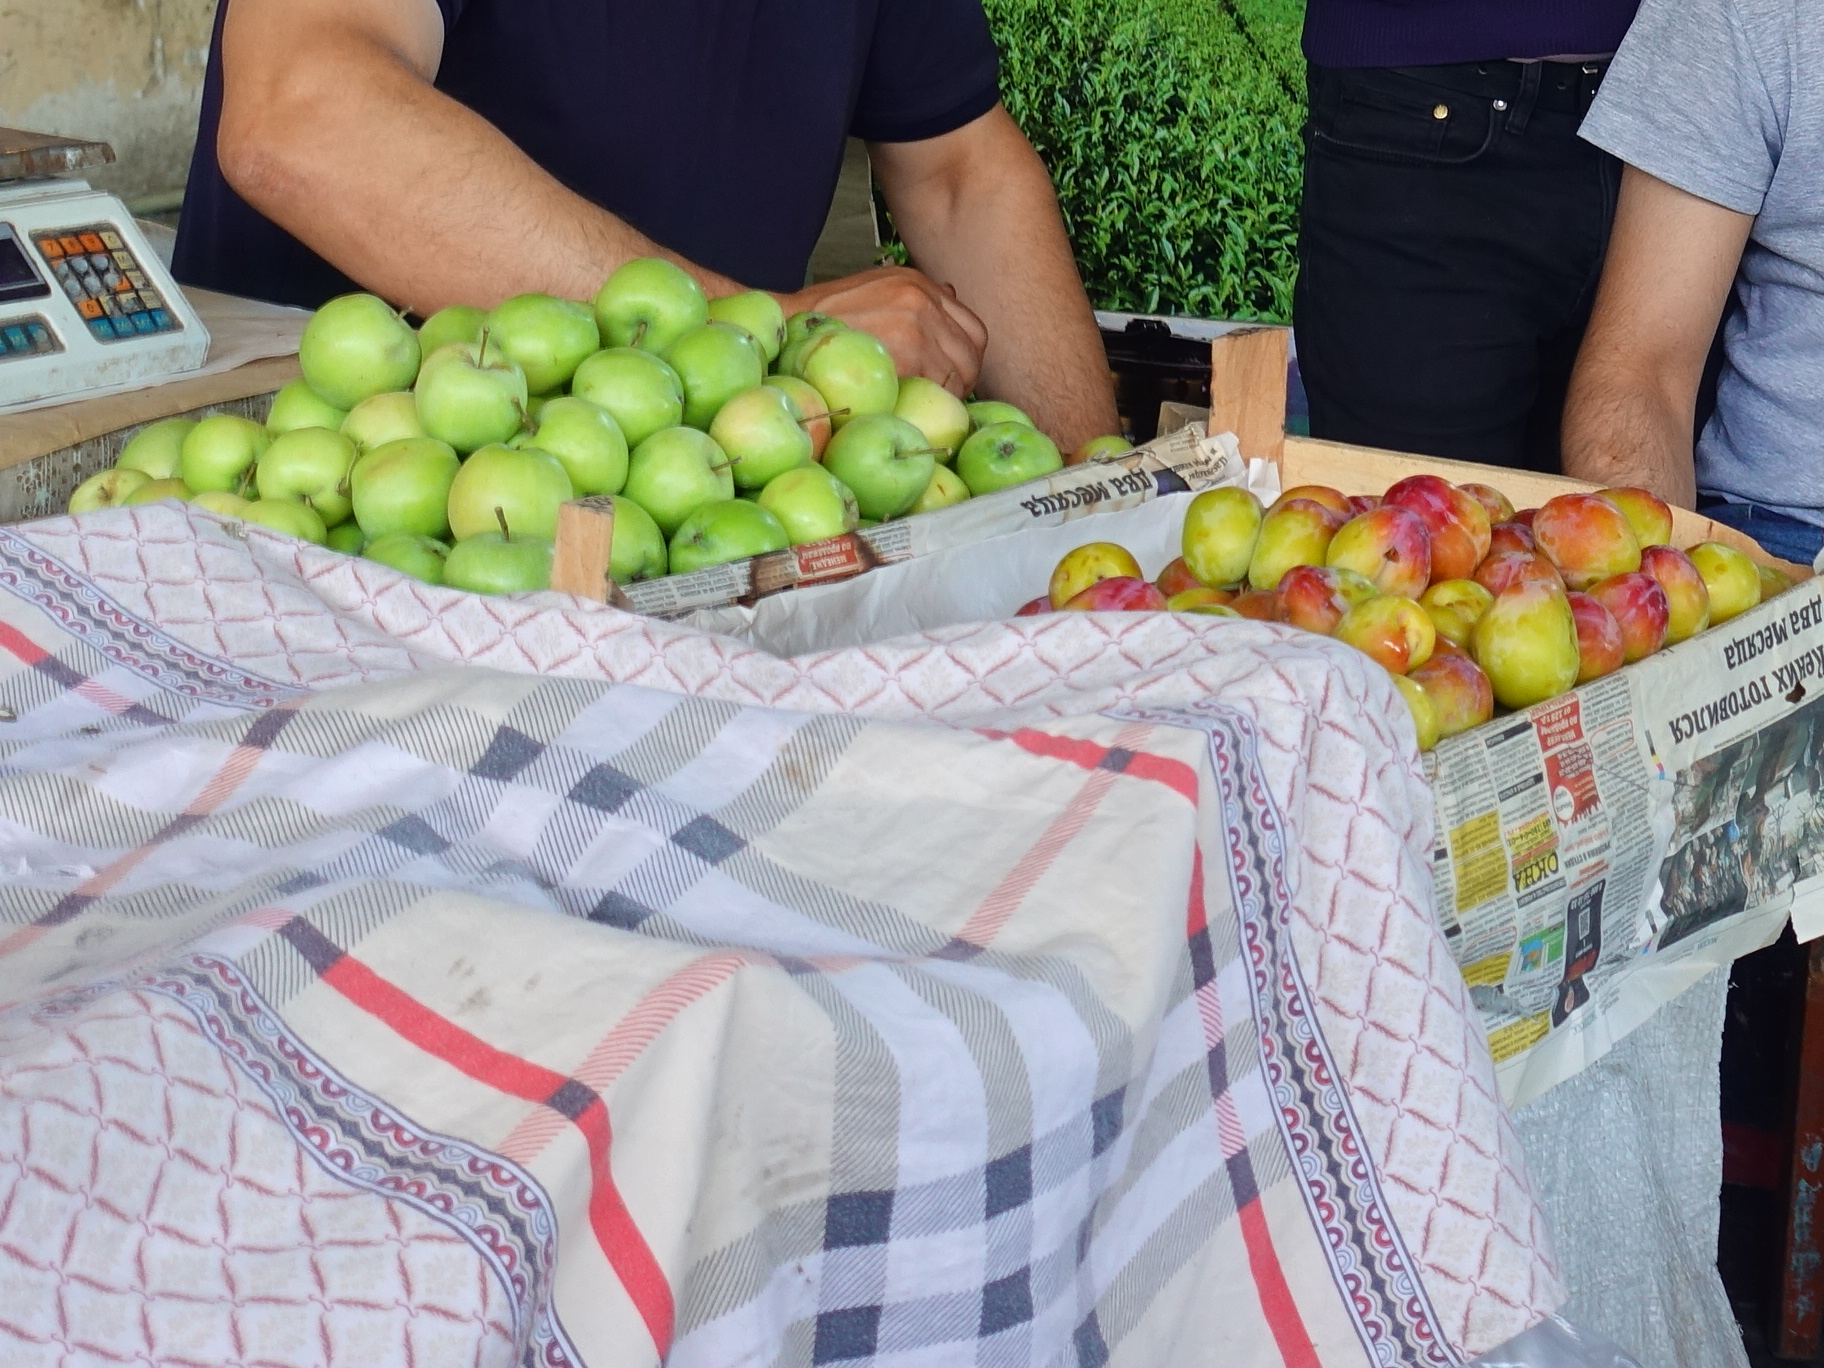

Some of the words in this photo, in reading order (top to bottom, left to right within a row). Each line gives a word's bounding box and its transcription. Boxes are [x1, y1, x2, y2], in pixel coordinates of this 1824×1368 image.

[1019, 481, 1111, 518] месяца
[1108, 467, 1154, 498] два
[811, 554, 847, 571] МЕНЕДЖЕ
[1789, 594, 1823, 636] два
[1723, 616, 1789, 671] месяца
[1668, 675, 1773, 745] готовился
[1512, 851, 1559, 893] ОКНА
